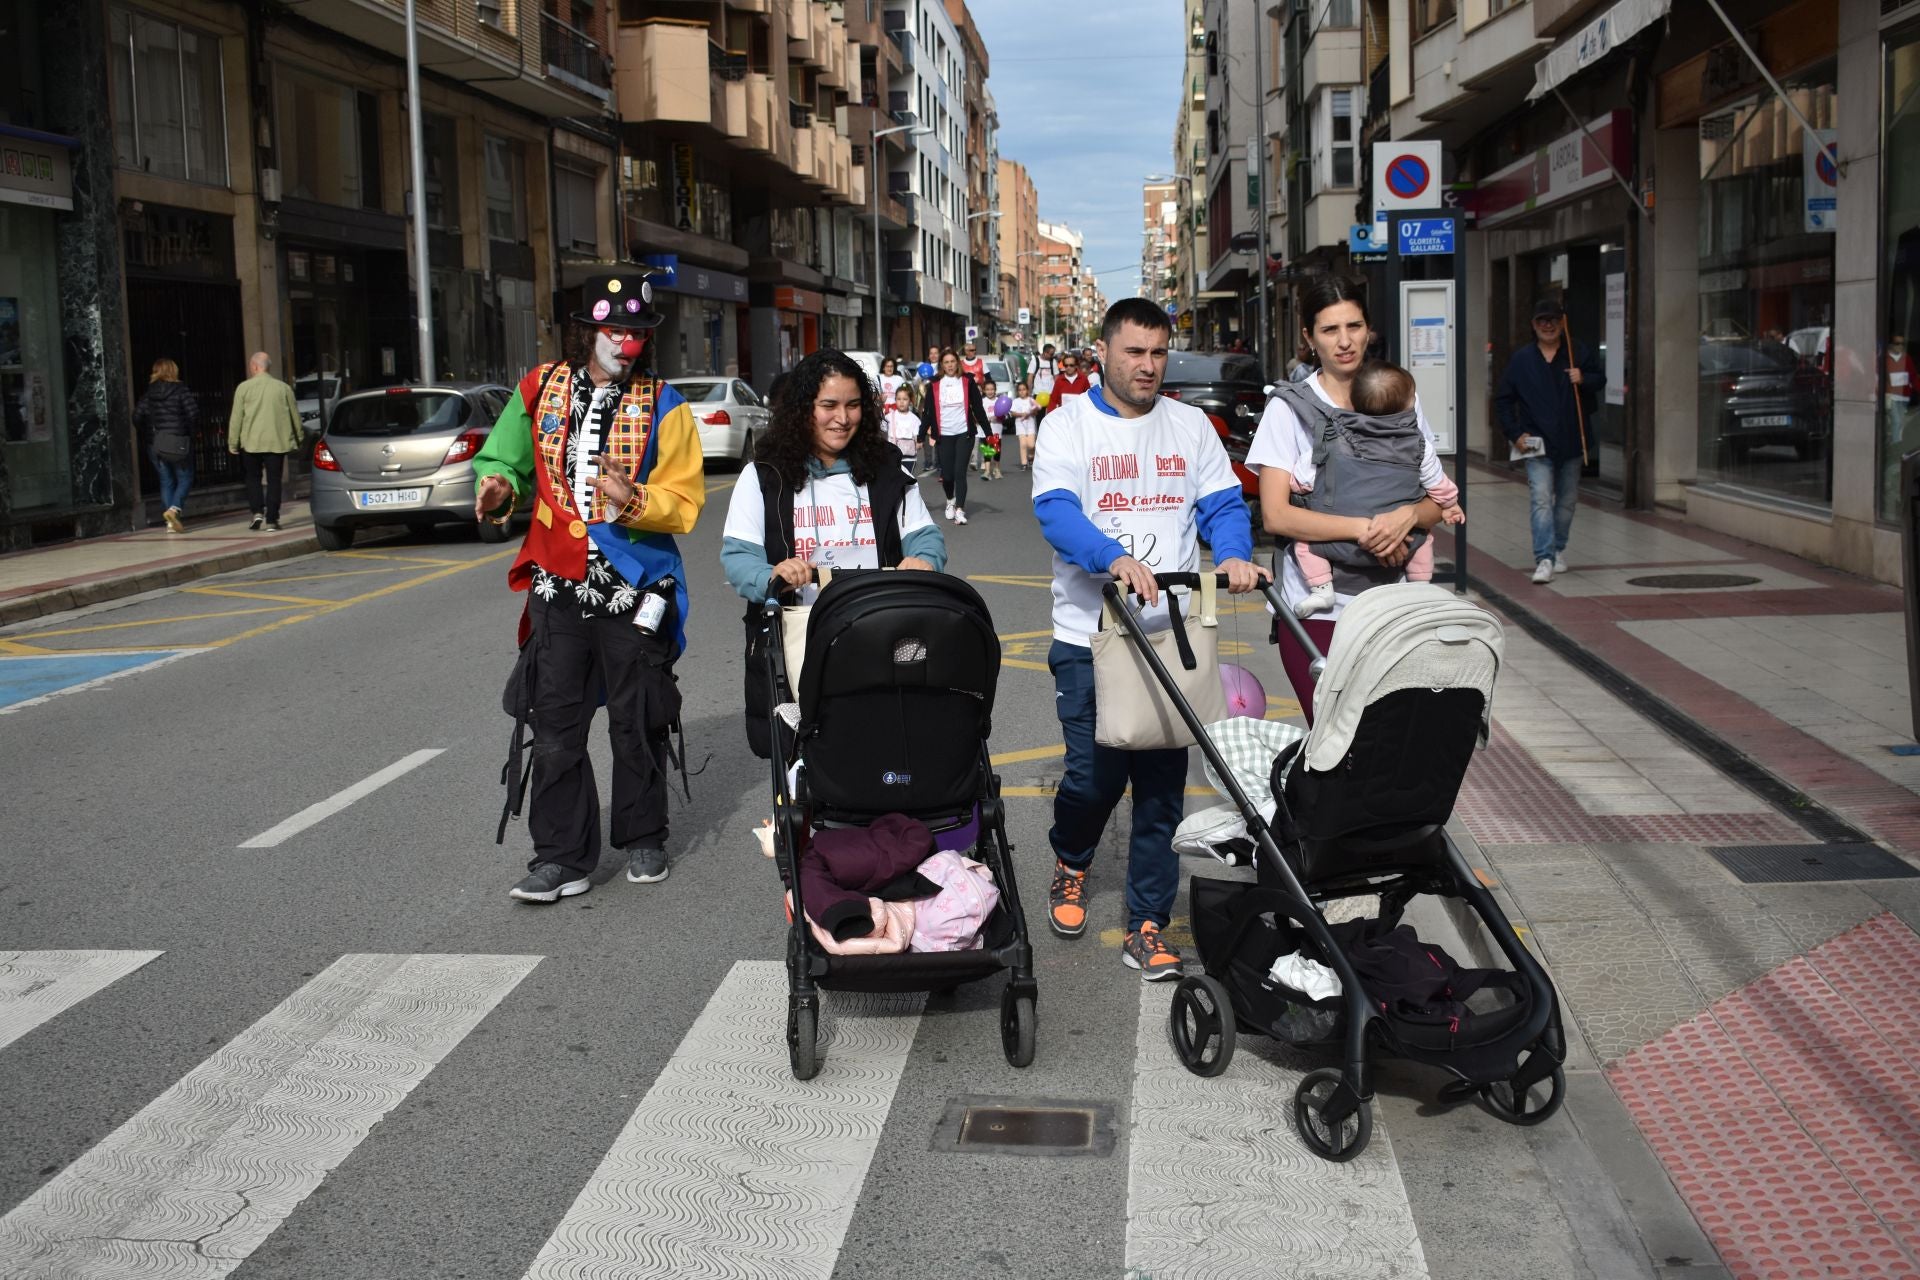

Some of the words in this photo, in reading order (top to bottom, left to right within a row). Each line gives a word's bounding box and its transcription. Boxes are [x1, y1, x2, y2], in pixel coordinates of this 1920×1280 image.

[1551, 141, 1579, 171] LABORAL
[1401, 223, 1421, 237] 07
[1096, 453, 1139, 481] SOLIDARIA
[1155, 454, 1185, 471] berlin
[368, 493, 393, 504] 5021
[1131, 493, 1185, 506] Cáritas
